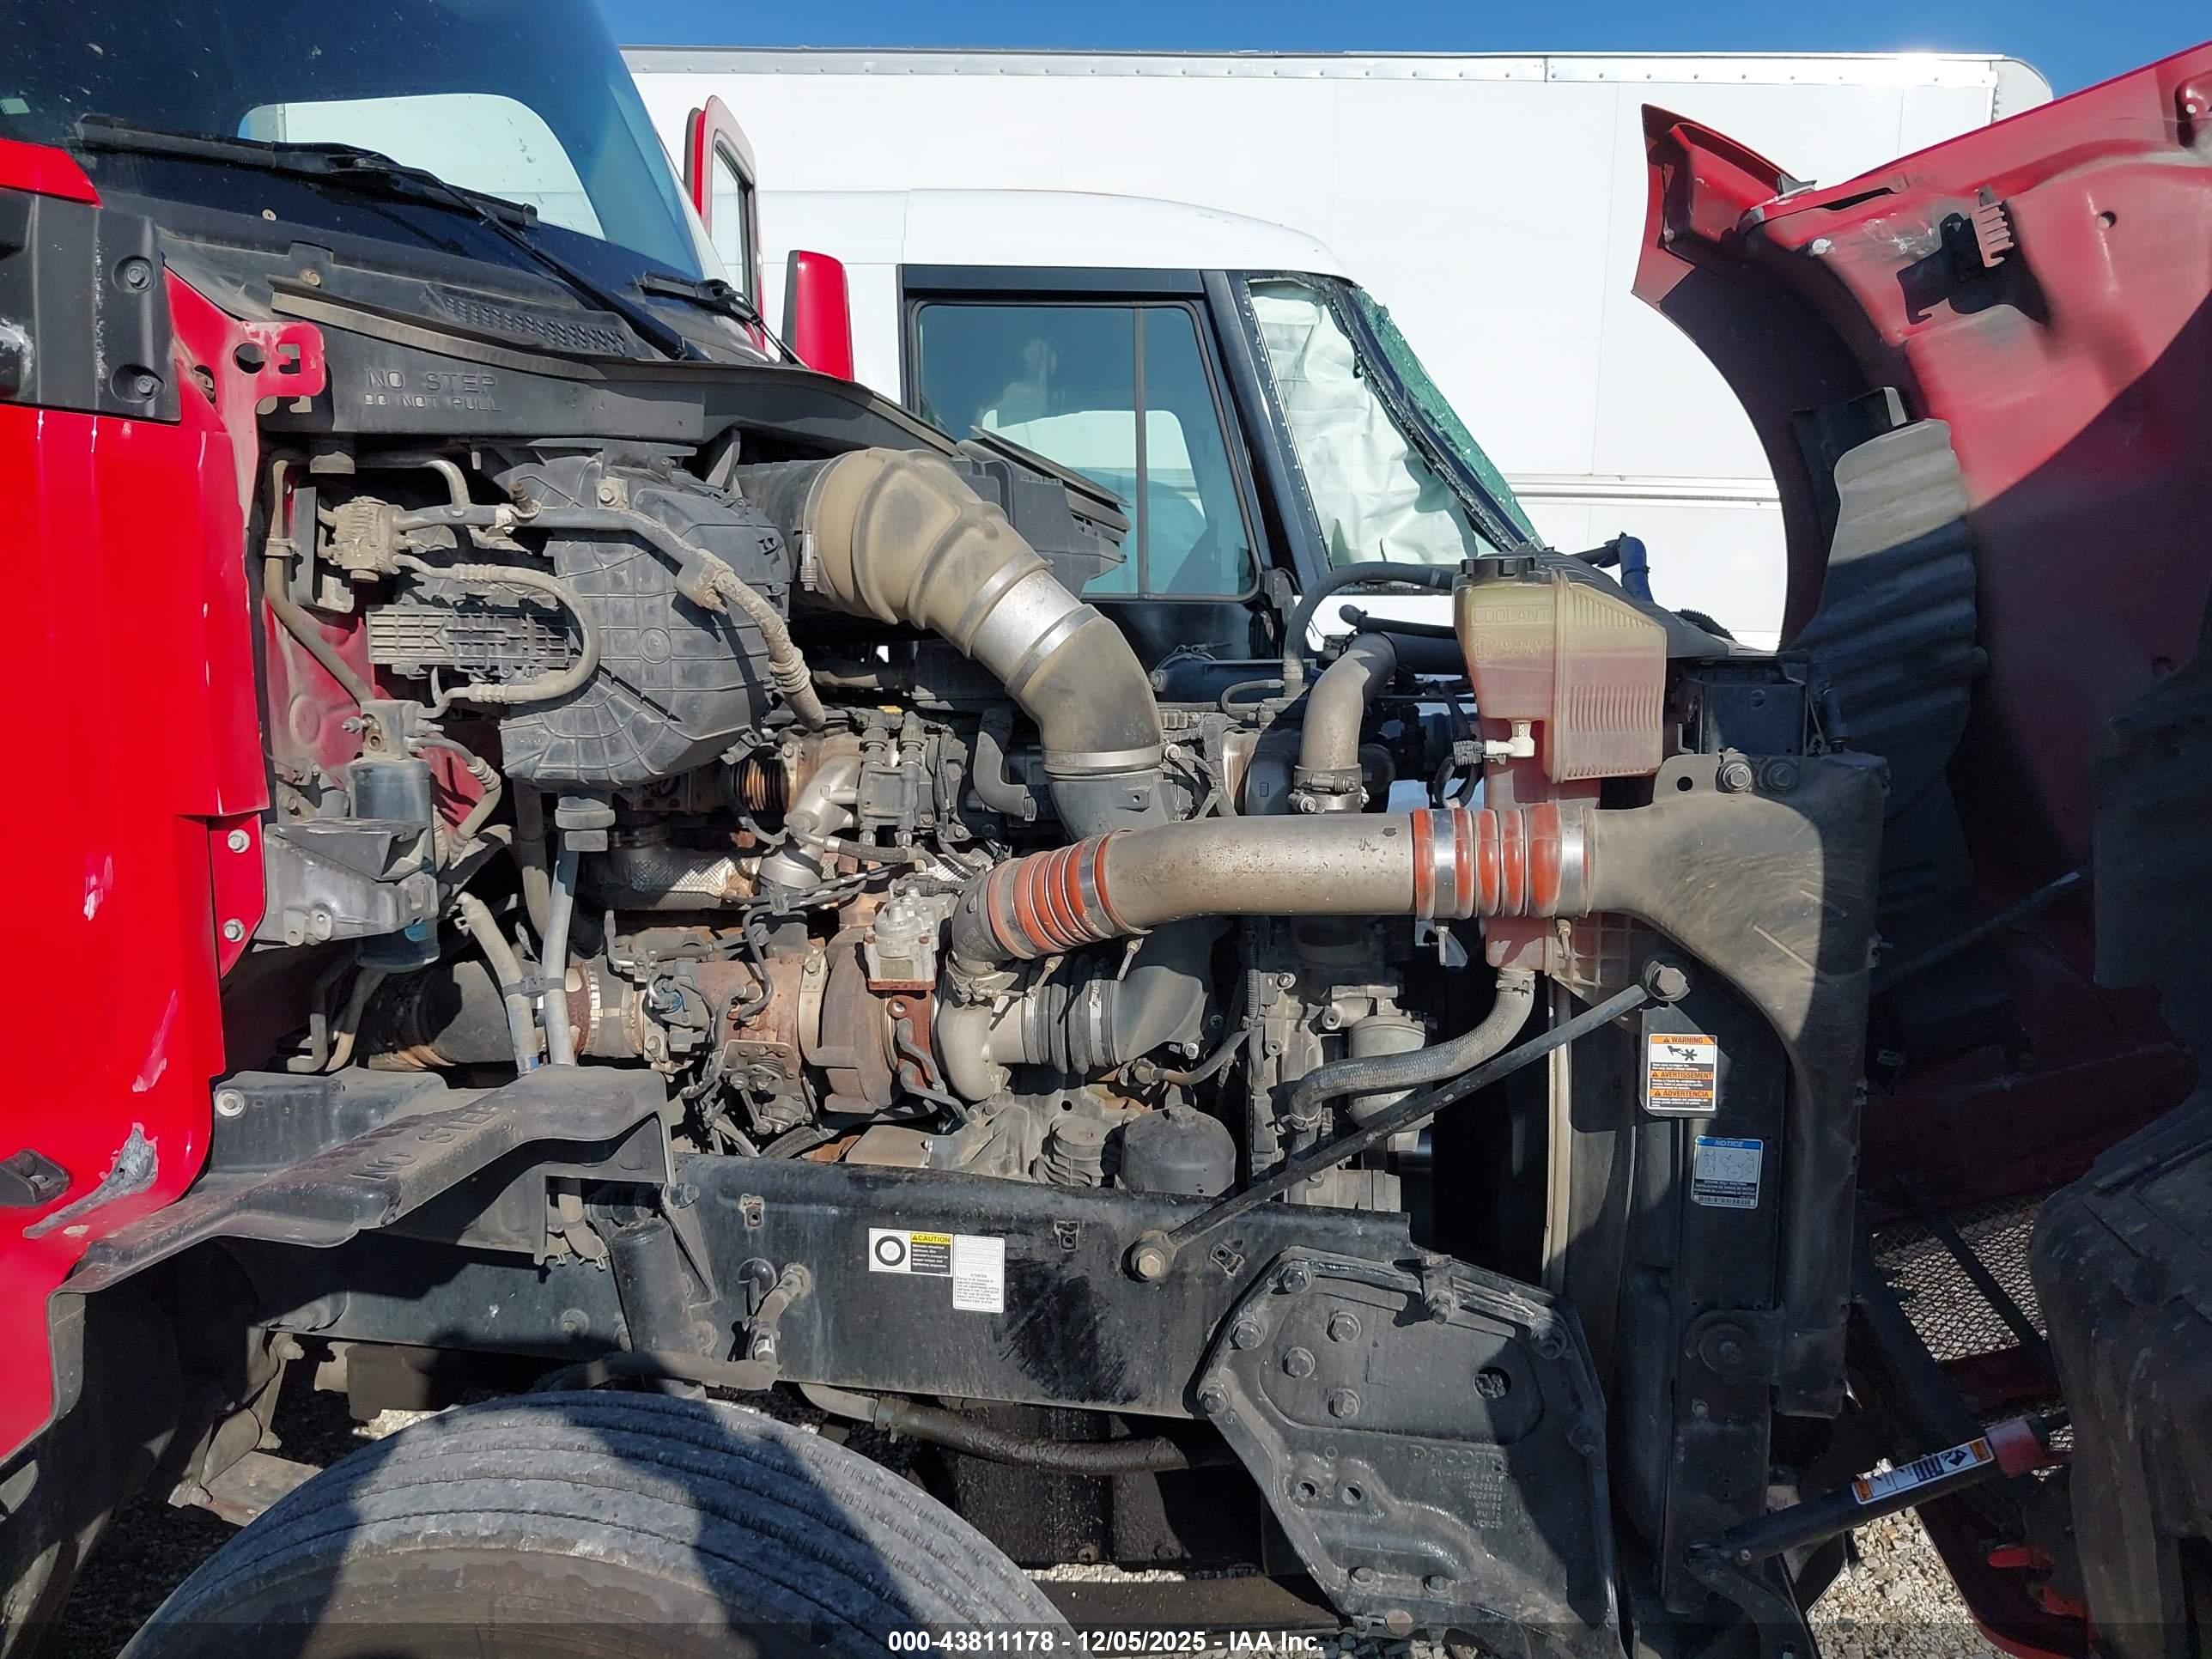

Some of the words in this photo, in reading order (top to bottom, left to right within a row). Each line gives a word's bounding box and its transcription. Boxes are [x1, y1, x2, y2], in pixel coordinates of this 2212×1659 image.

[368, 369, 404, 389] NO
[426, 373, 498, 393] STEP
[365, 394, 387, 406] DO
[401, 394, 437, 409] NOT
[453, 397, 502, 412] PULL
[1473, 607, 1549, 624] COOLANT
[1715, 1139, 1744, 1148] NOTICE
[918, 1235, 951, 1243] CAUTION
